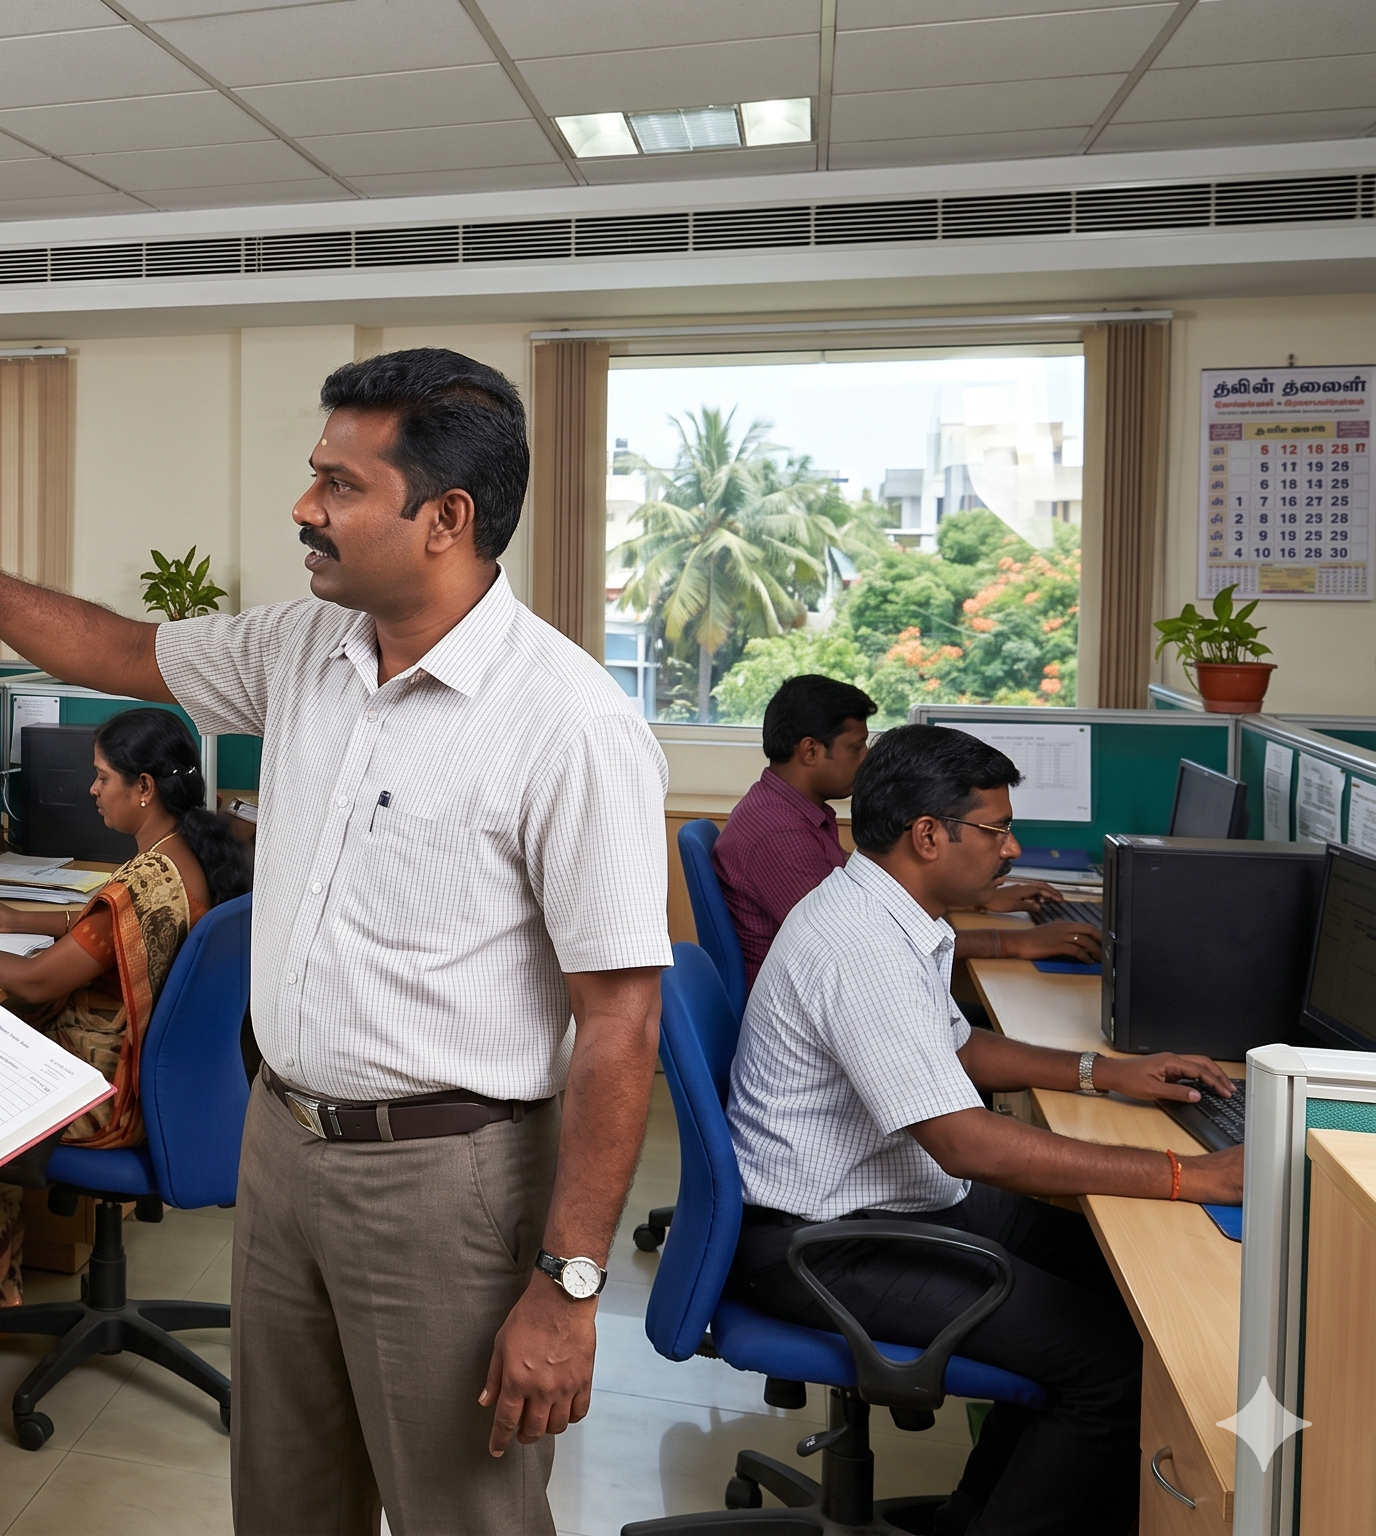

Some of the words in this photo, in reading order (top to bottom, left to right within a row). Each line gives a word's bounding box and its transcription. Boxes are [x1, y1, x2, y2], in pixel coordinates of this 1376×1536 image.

[1281, 444, 1298, 455] 12
[1307, 461, 1324, 472] 19
[1260, 479, 1269, 490] 6
[1280, 479, 1297, 490] 18
[1236, 496, 1242, 507] 1
[1260, 496, 1268, 507] 7
[1280, 496, 1297, 507] 16
[1305, 496, 1323, 507] 27
[1234, 513, 1243, 524] 2
[1259, 513, 1268, 524] 8
[1280, 513, 1297, 524] 18
[1330, 513, 1348, 524] 28
[1234, 530, 1243, 541] 3
[1259, 530, 1268, 541] 9
[1330, 530, 1348, 541] 29
[1234, 547, 1243, 558] 4
[1254, 547, 1271, 558] 10
[1280, 547, 1296, 558] 16
[1330, 547, 1348, 558] 30
